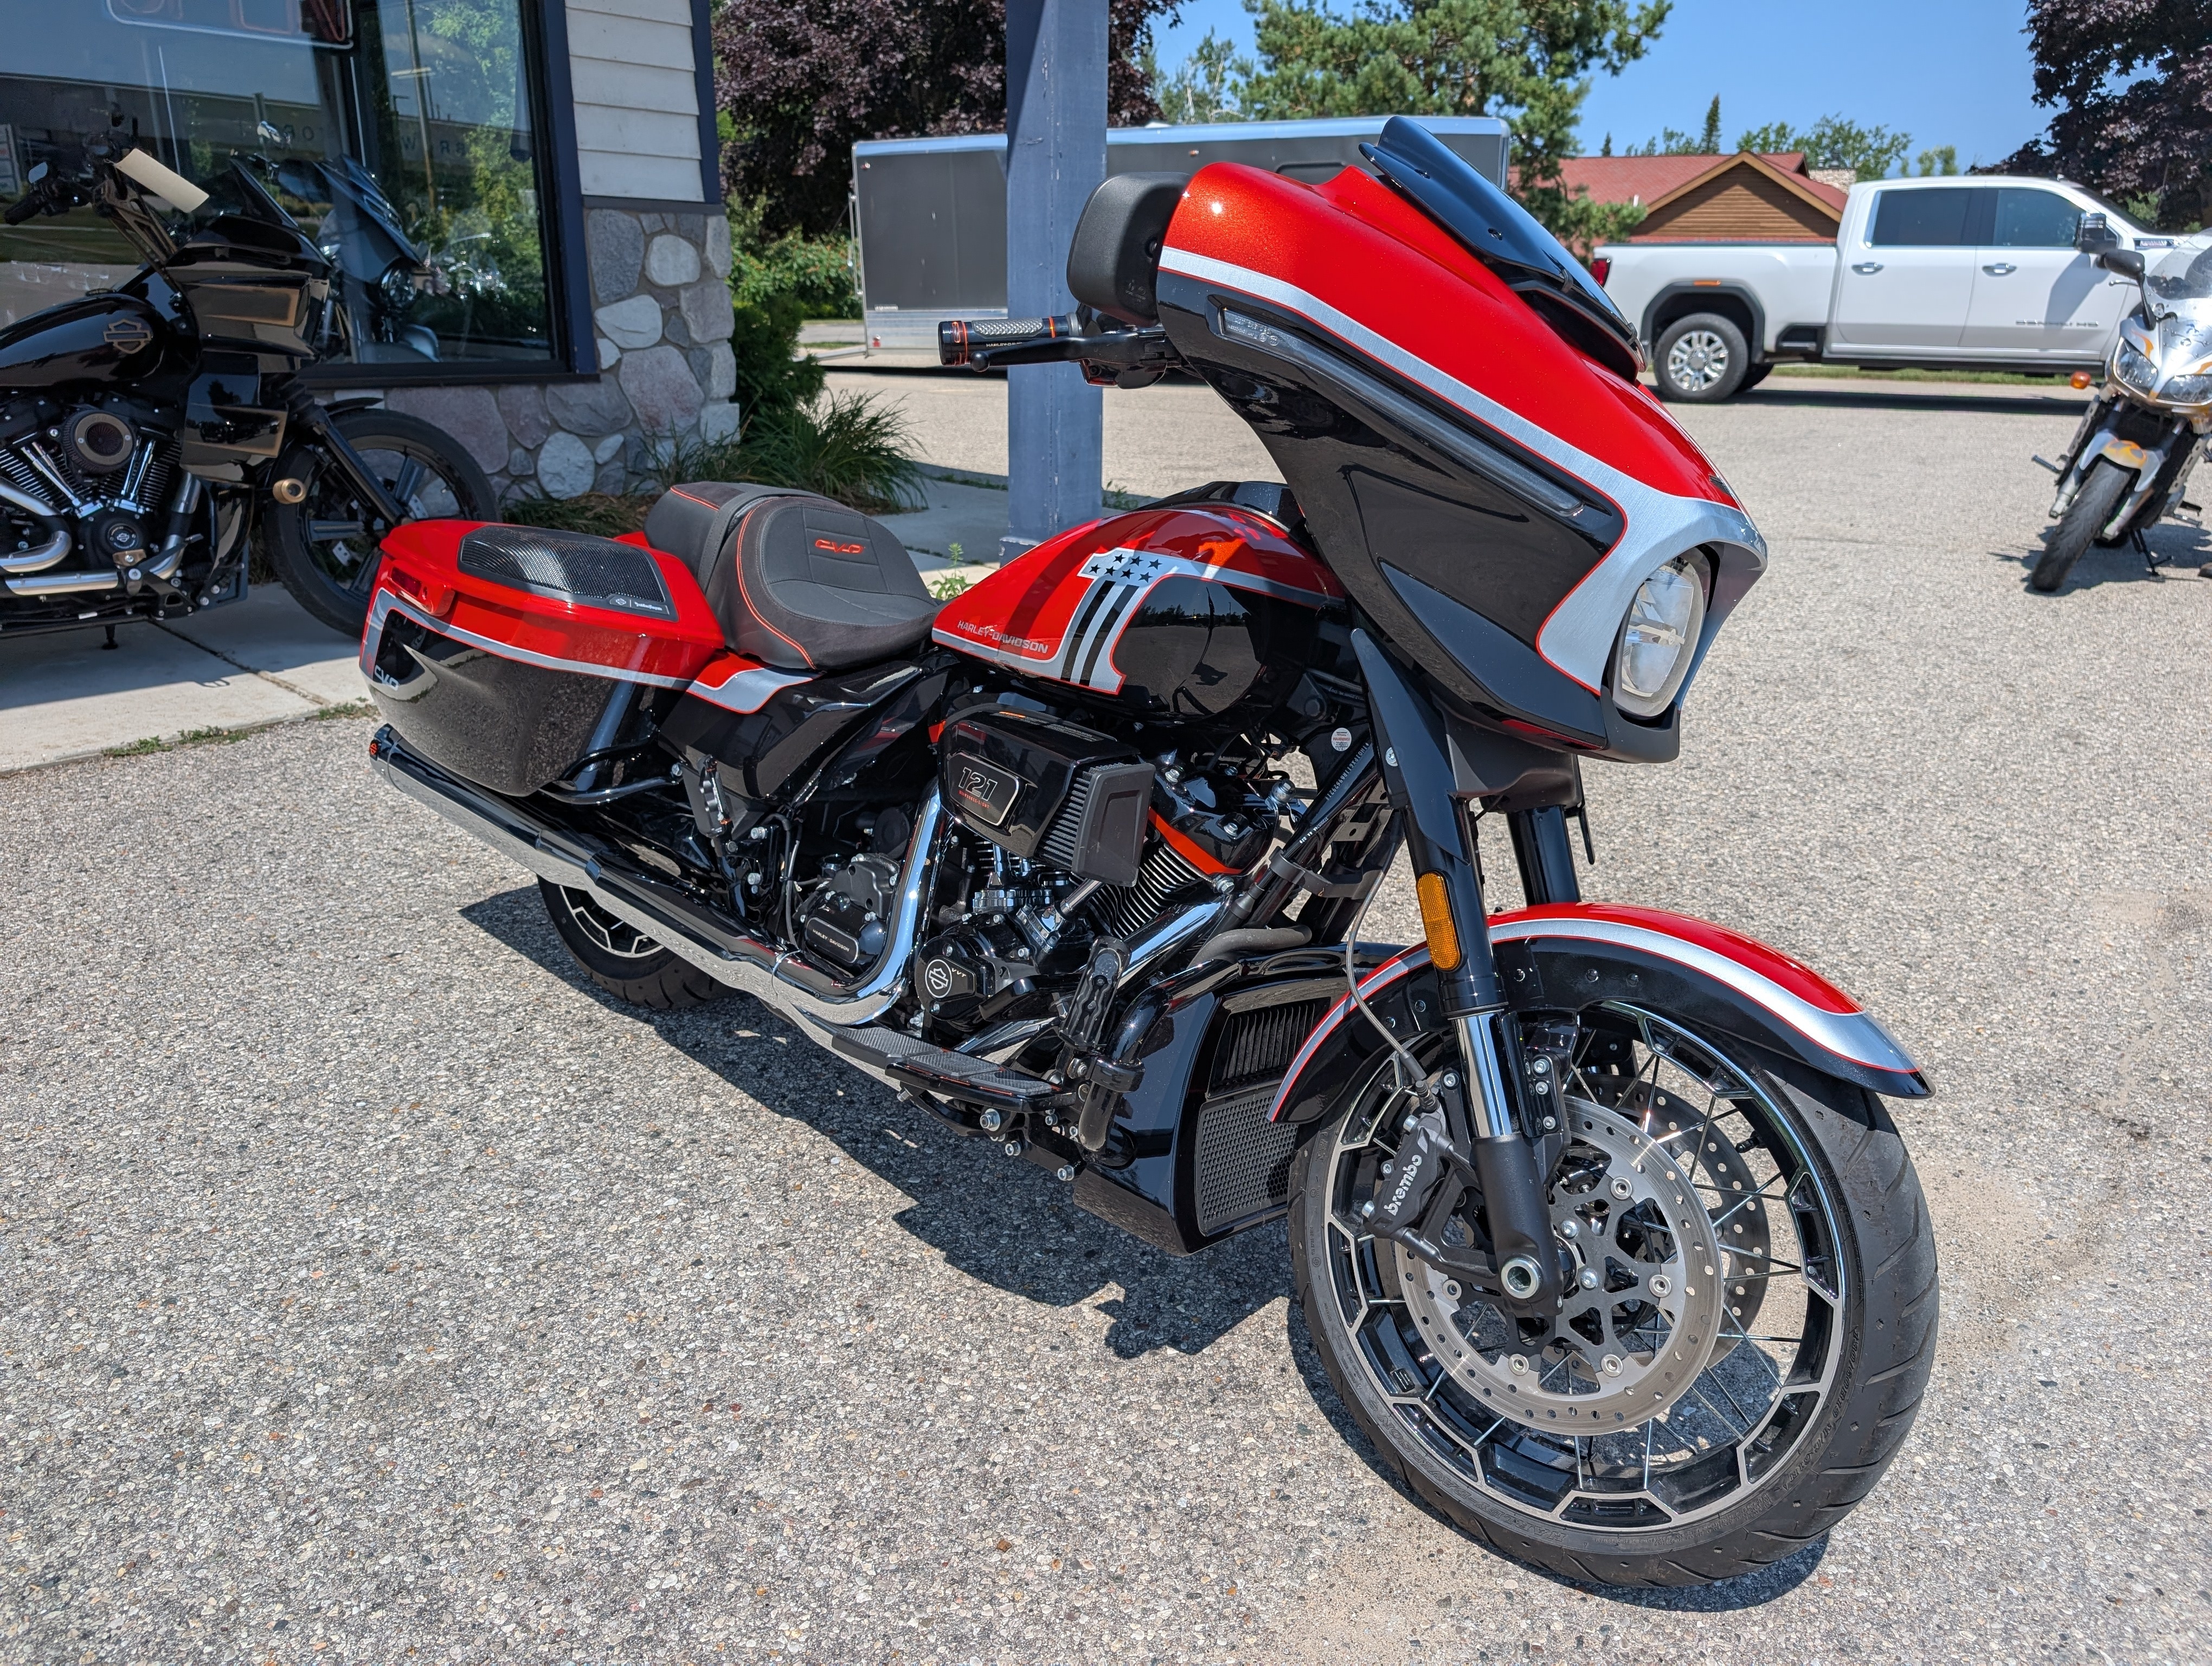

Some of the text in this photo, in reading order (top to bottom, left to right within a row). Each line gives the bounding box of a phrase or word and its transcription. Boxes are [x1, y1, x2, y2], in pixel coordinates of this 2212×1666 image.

[815, 539, 864, 554] CVO
[957, 620, 1049, 654] HARLEY-DAVIDSON
[375, 664, 399, 691] CVO
[959, 767, 998, 802] 121
[951, 967, 967, 979] VVT
[1384, 1155, 1422, 1216] brembo
[1378, 1415, 1565, 1542] HARLEY-DAVIDSON
